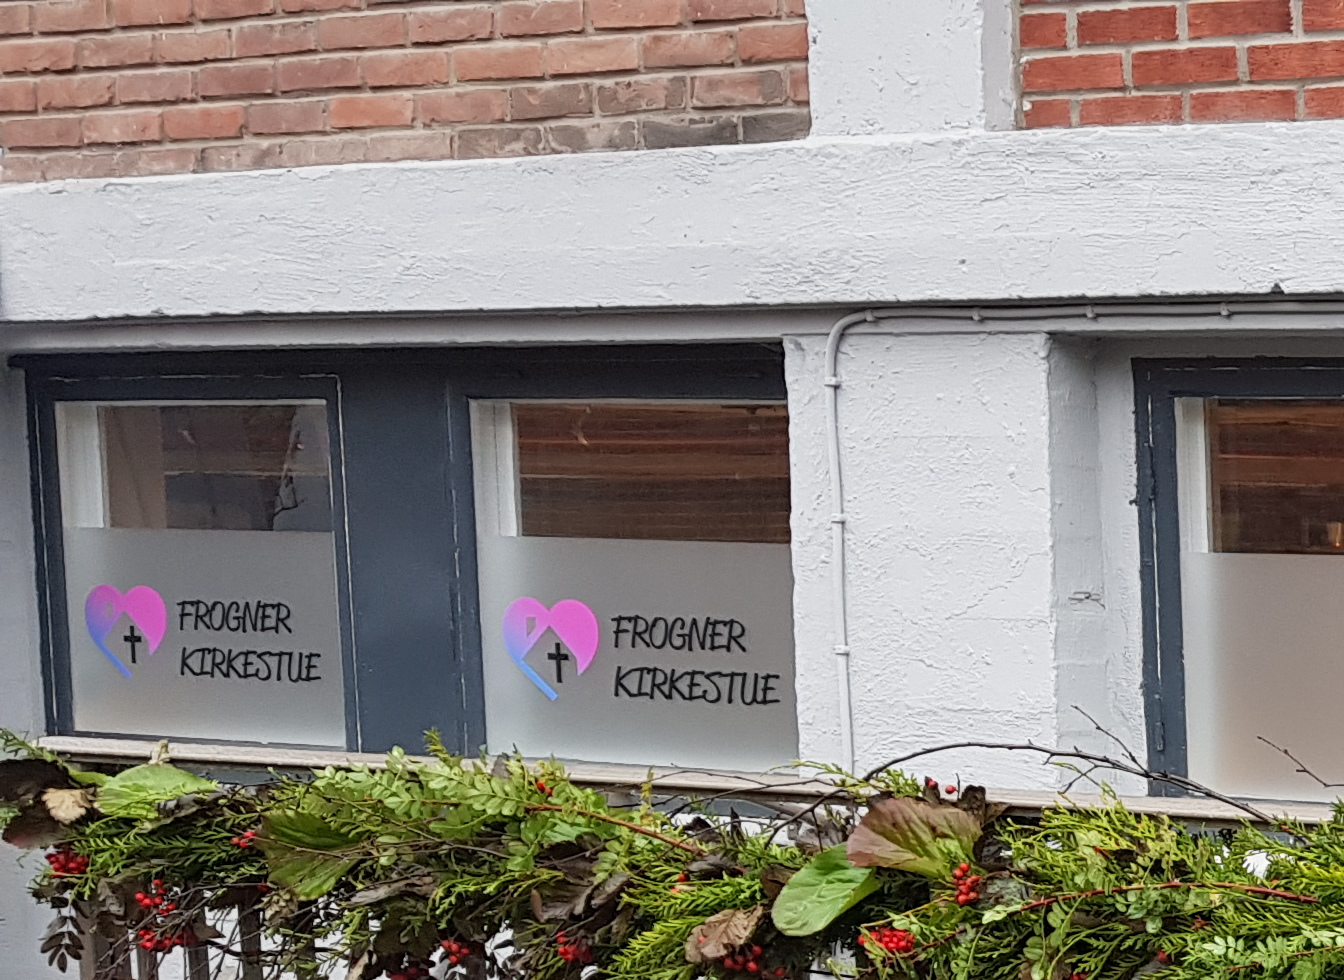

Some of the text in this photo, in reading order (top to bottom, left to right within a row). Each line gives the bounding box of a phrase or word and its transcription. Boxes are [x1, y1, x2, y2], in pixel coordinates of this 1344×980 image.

[177, 600, 292, 634] FROGNER
[611, 614, 747, 652] FROGNER
[180, 647, 321, 683] KIRKESTUE
[614, 666, 780, 705] KIRKESTUE
